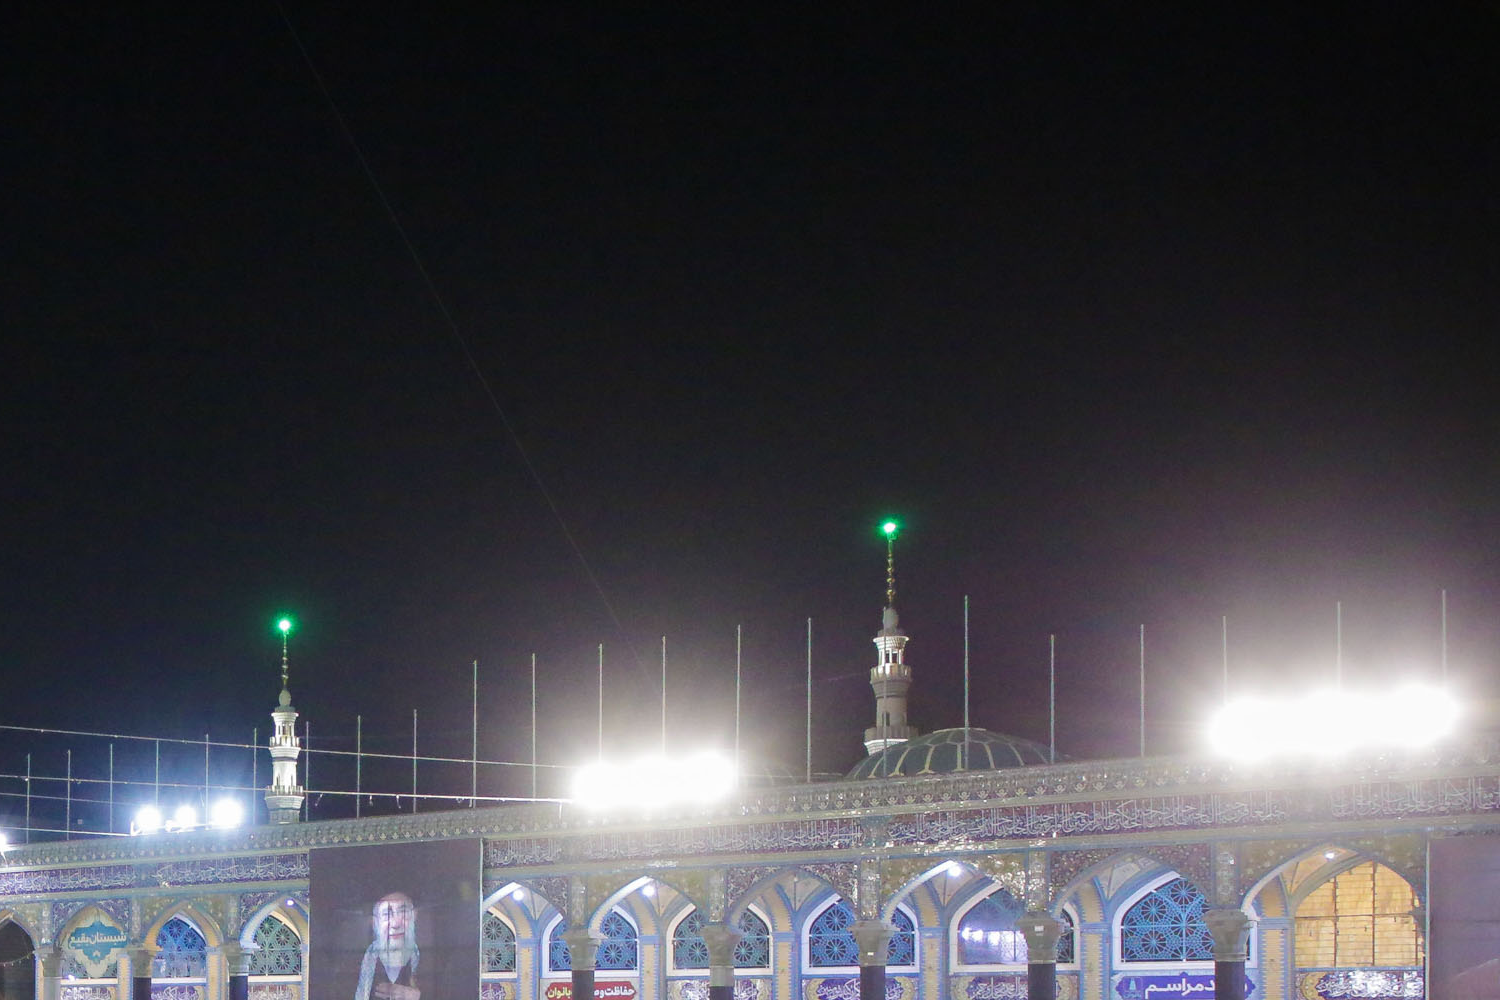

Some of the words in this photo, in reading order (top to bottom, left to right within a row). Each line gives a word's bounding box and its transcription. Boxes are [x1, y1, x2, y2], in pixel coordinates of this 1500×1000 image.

[90, 930, 127, 946] شبستان
[605, 986, 635, 996] حفاظت
[1144, 978, 1204, 1000] مراسم
